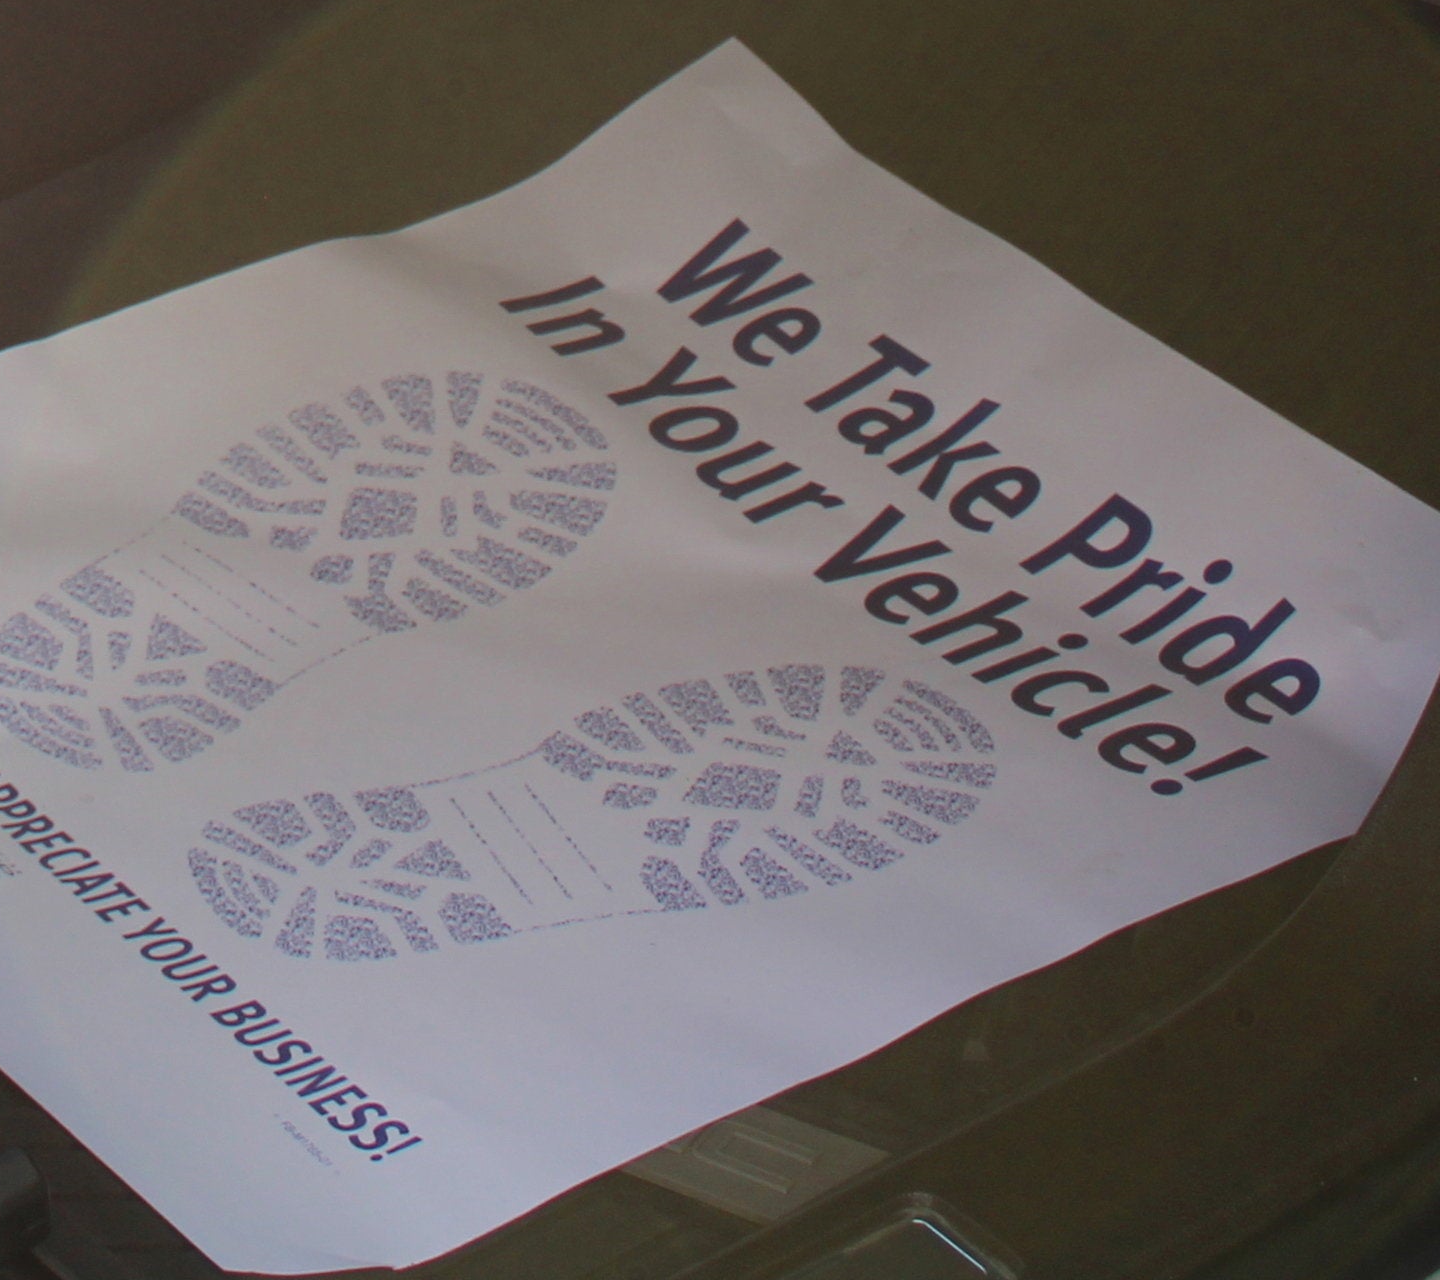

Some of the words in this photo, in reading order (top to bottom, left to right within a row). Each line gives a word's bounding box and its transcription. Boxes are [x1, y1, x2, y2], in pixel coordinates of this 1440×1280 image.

[497, 275, 627, 358] In
[606, 345, 846, 525] Your
[812, 503, 1270, 797] Vehicle!
[655, 217, 822, 368] We
[802, 333, 1043, 534] Take
[1018, 492, 1322, 726] Pride
[121, 915, 238, 1004] YOUR
[208, 998, 424, 1163] BUSINESS!
